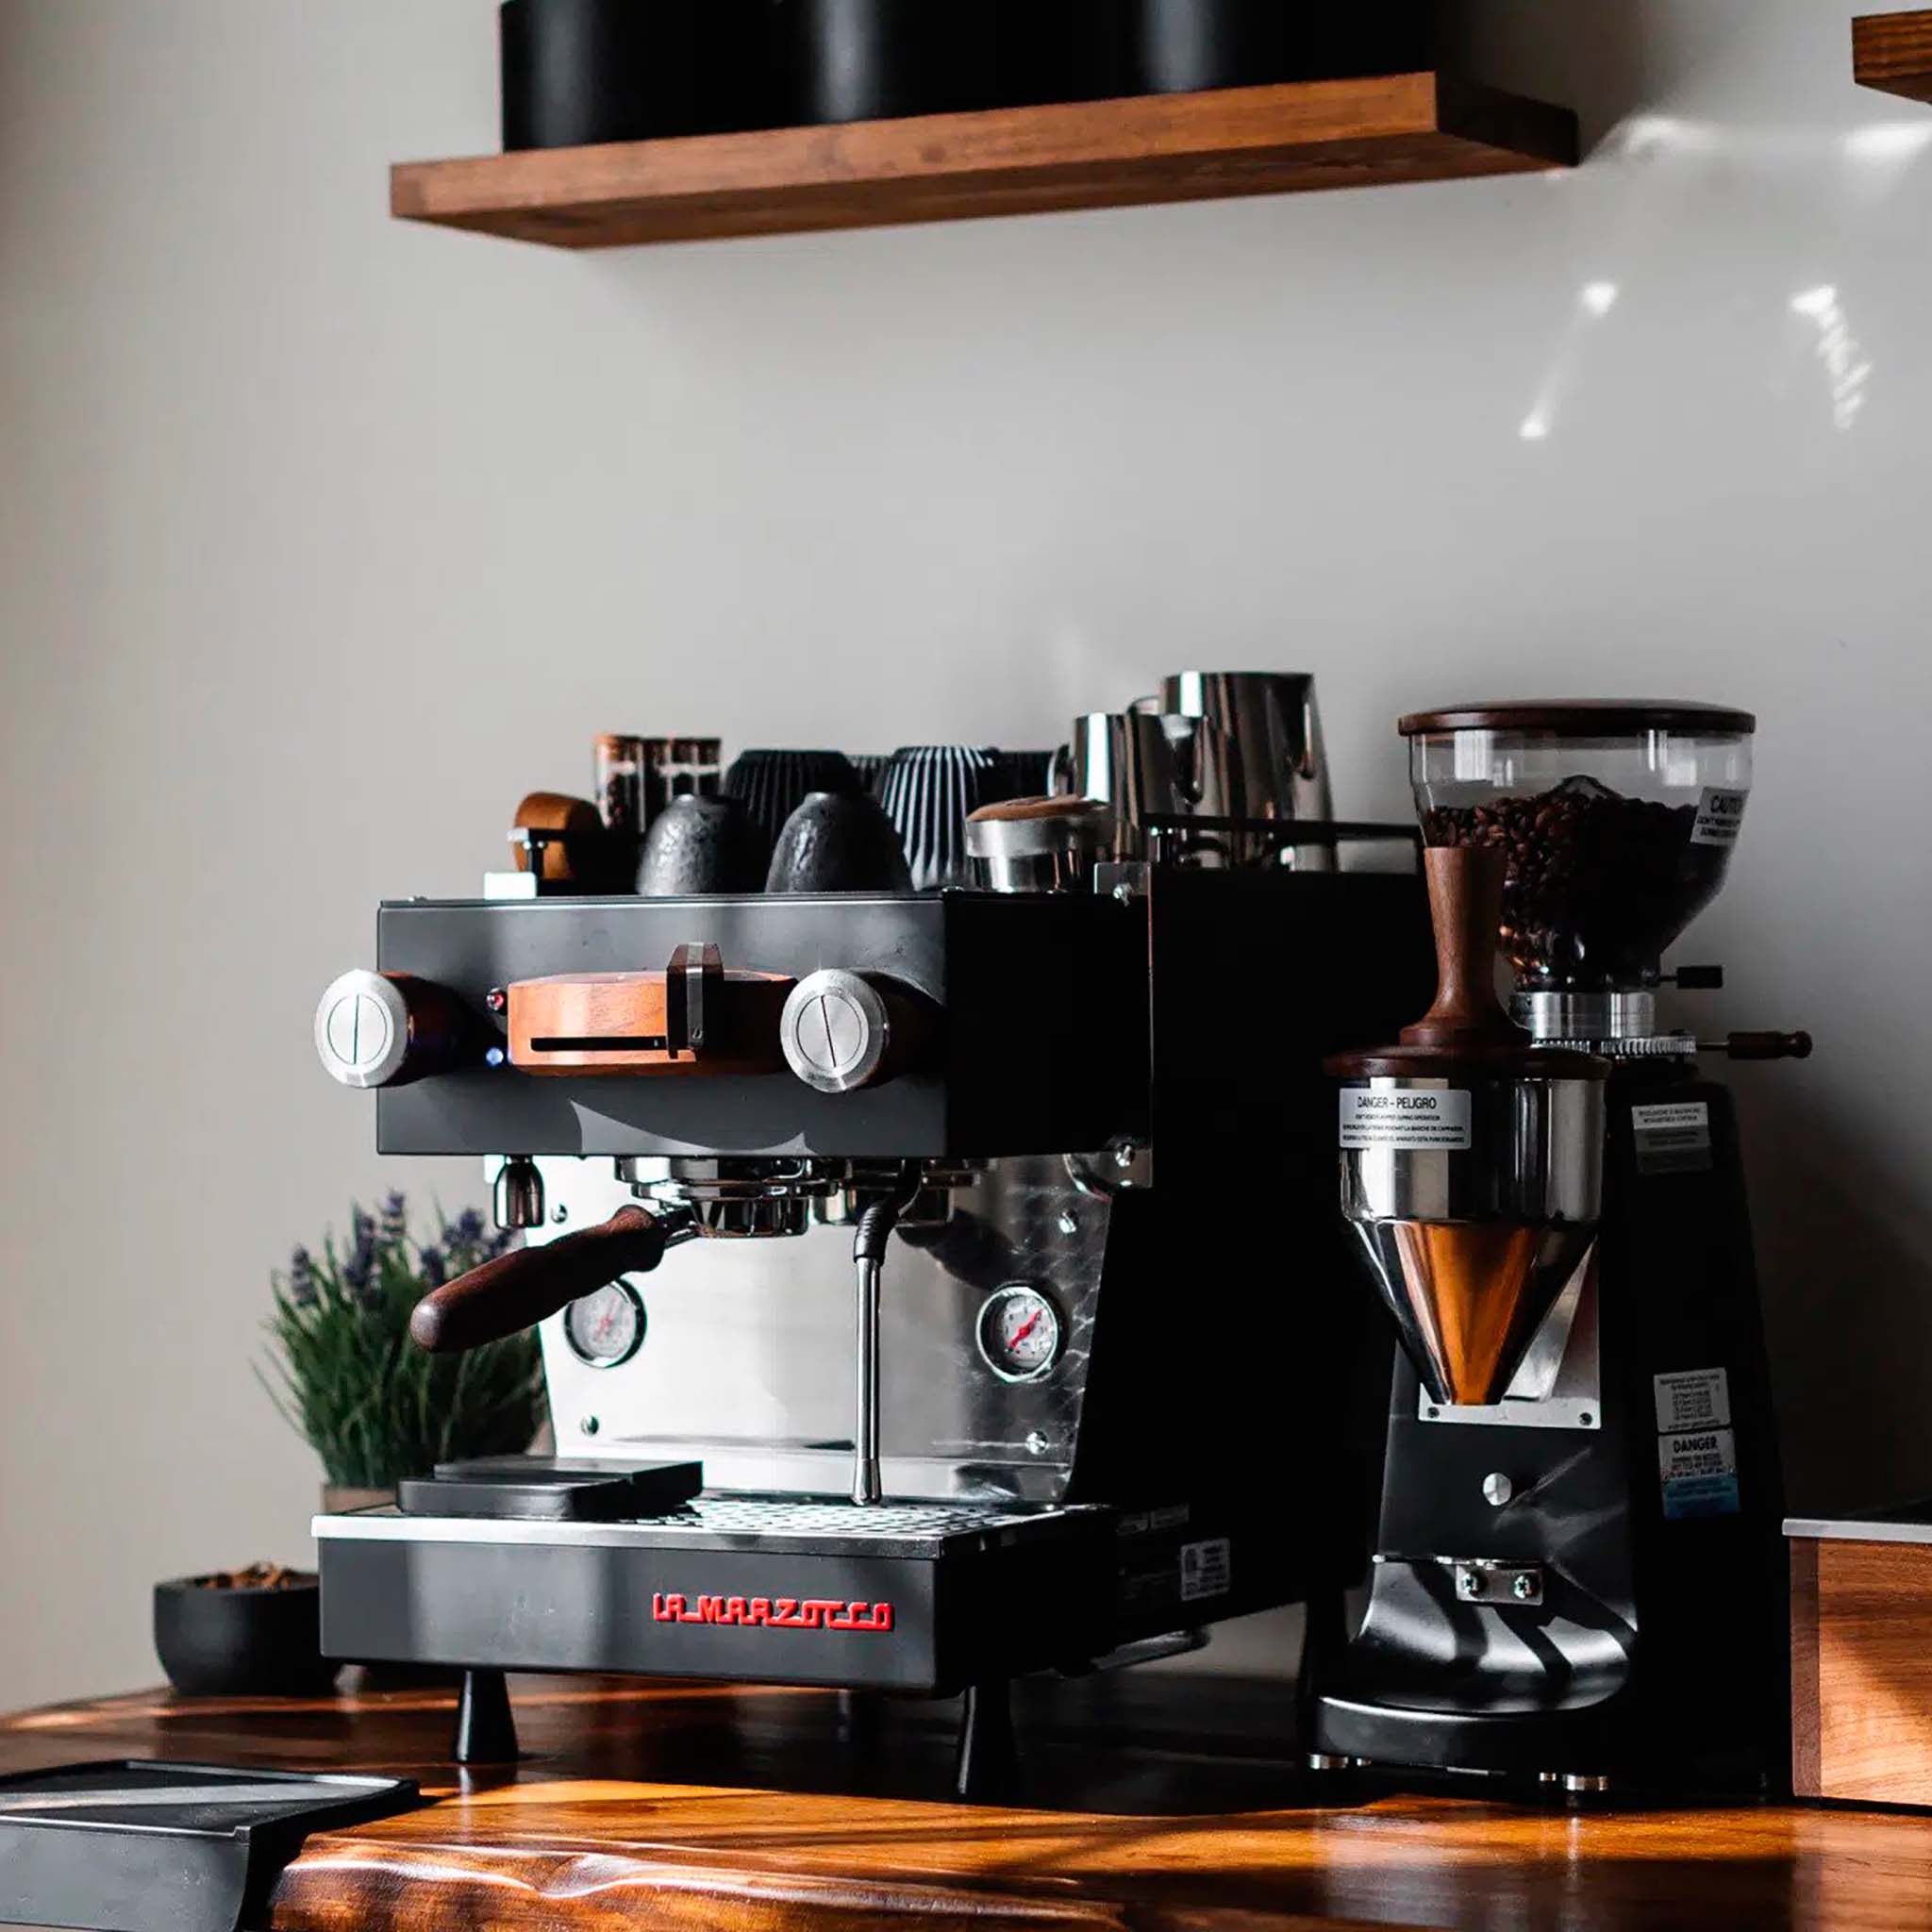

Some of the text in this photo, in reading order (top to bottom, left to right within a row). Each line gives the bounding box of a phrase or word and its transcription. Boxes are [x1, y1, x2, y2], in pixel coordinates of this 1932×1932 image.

[1357, 1096, 1390, 1108] DANGER
[1396, 1096, 1437, 1109] PELIGRO
[1673, 1436, 1718, 1453] DANGER
